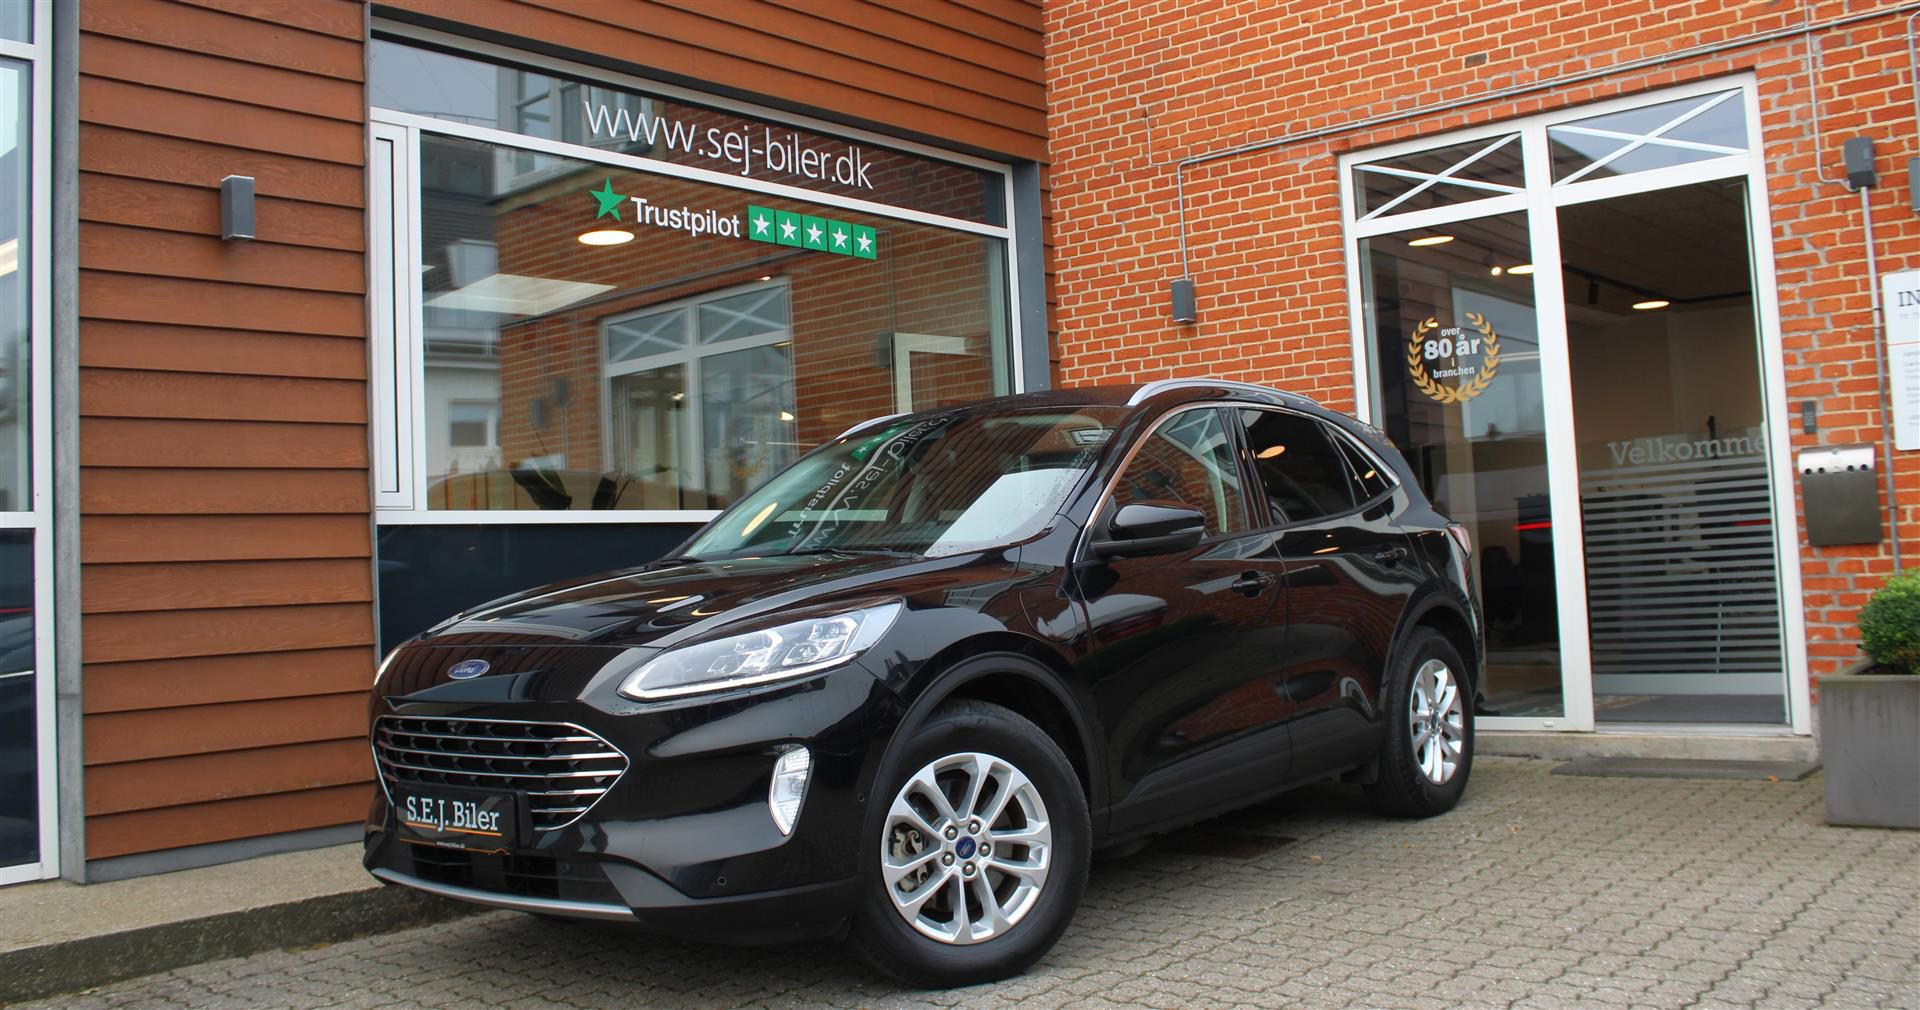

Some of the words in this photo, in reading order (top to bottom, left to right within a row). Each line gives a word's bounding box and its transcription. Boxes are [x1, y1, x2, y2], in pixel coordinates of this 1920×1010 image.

[584, 101, 874, 190] www.sej-biler.dk
[631, 196, 741, 238] Trustpilot
[1441, 327, 1460, 337] over
[1424, 338, 1453, 360] 80
[1455, 334, 1480, 356] år
[1433, 366, 1475, 378] branchen
[1451, 358, 1455, 367] i
[407, 795, 449, 832] S.E.J.
[452, 800, 500, 831] Biler
